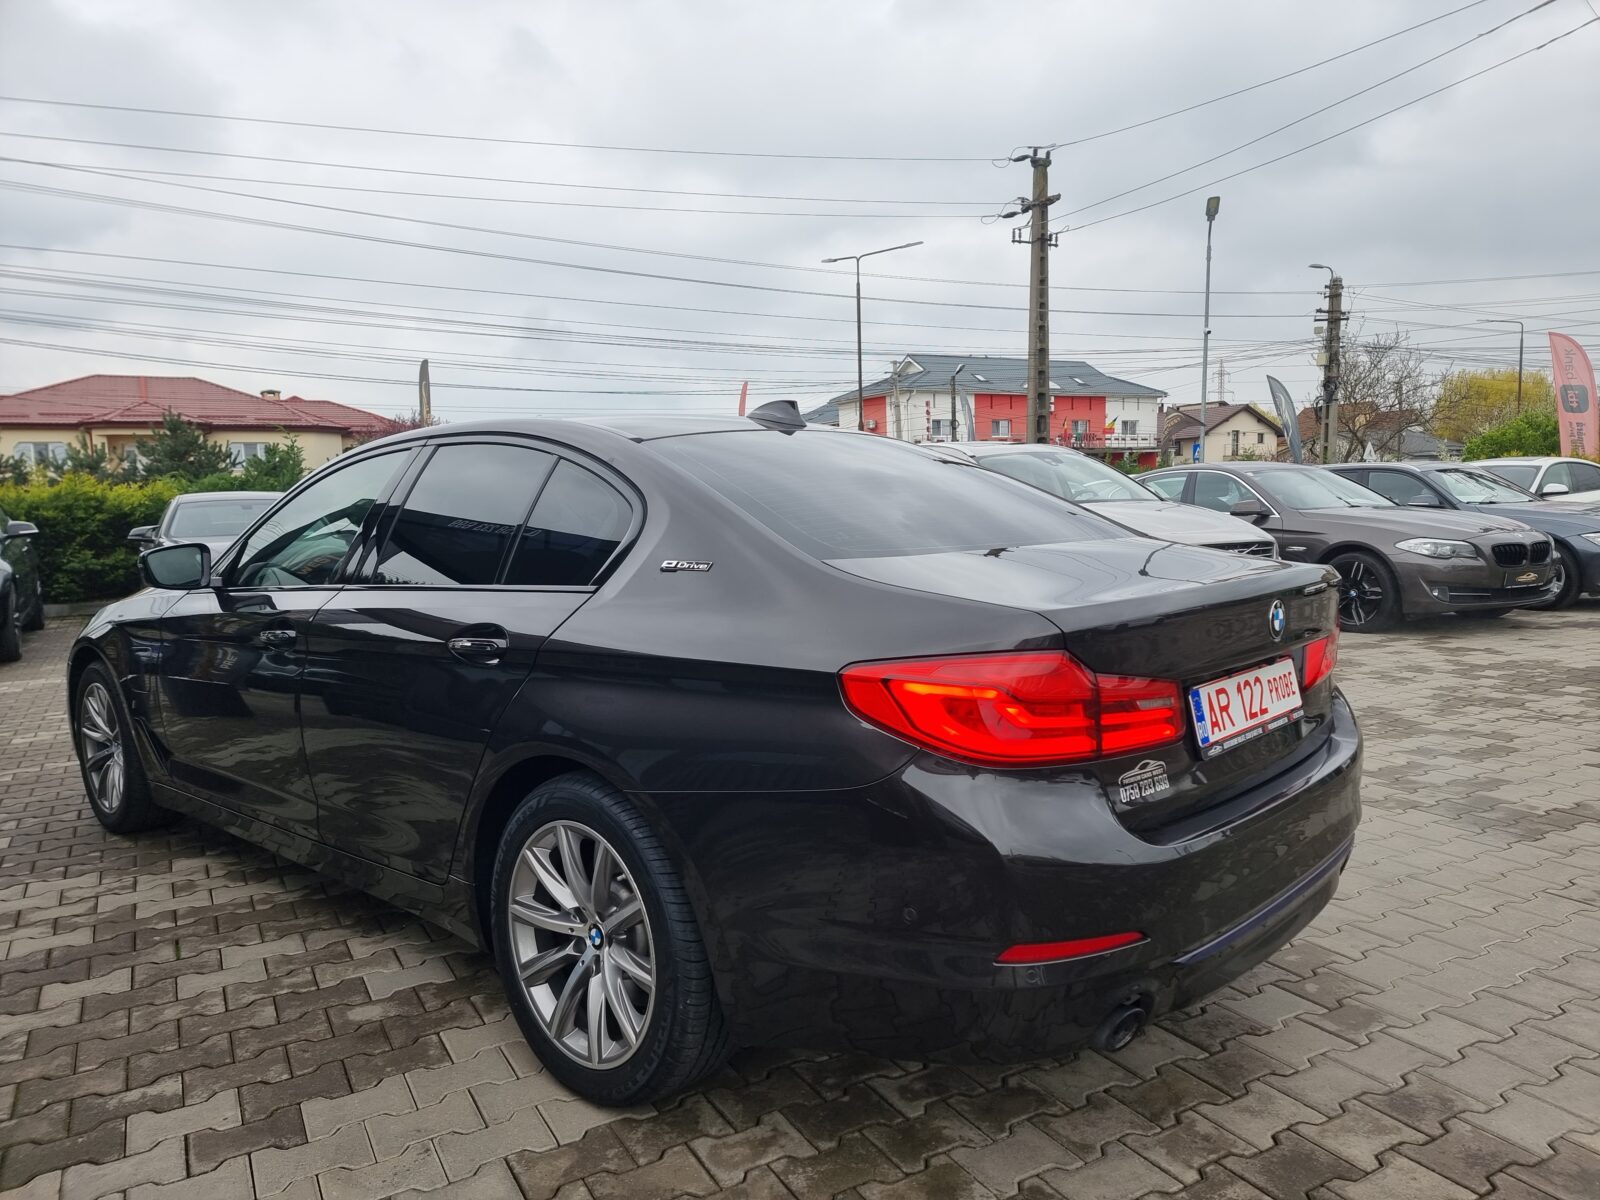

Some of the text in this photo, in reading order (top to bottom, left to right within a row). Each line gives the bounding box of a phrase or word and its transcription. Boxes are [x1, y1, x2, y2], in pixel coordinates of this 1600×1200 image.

[1207, 672, 1296, 736] AR 122 PROBE
[1120, 783, 1140, 803] 0758
